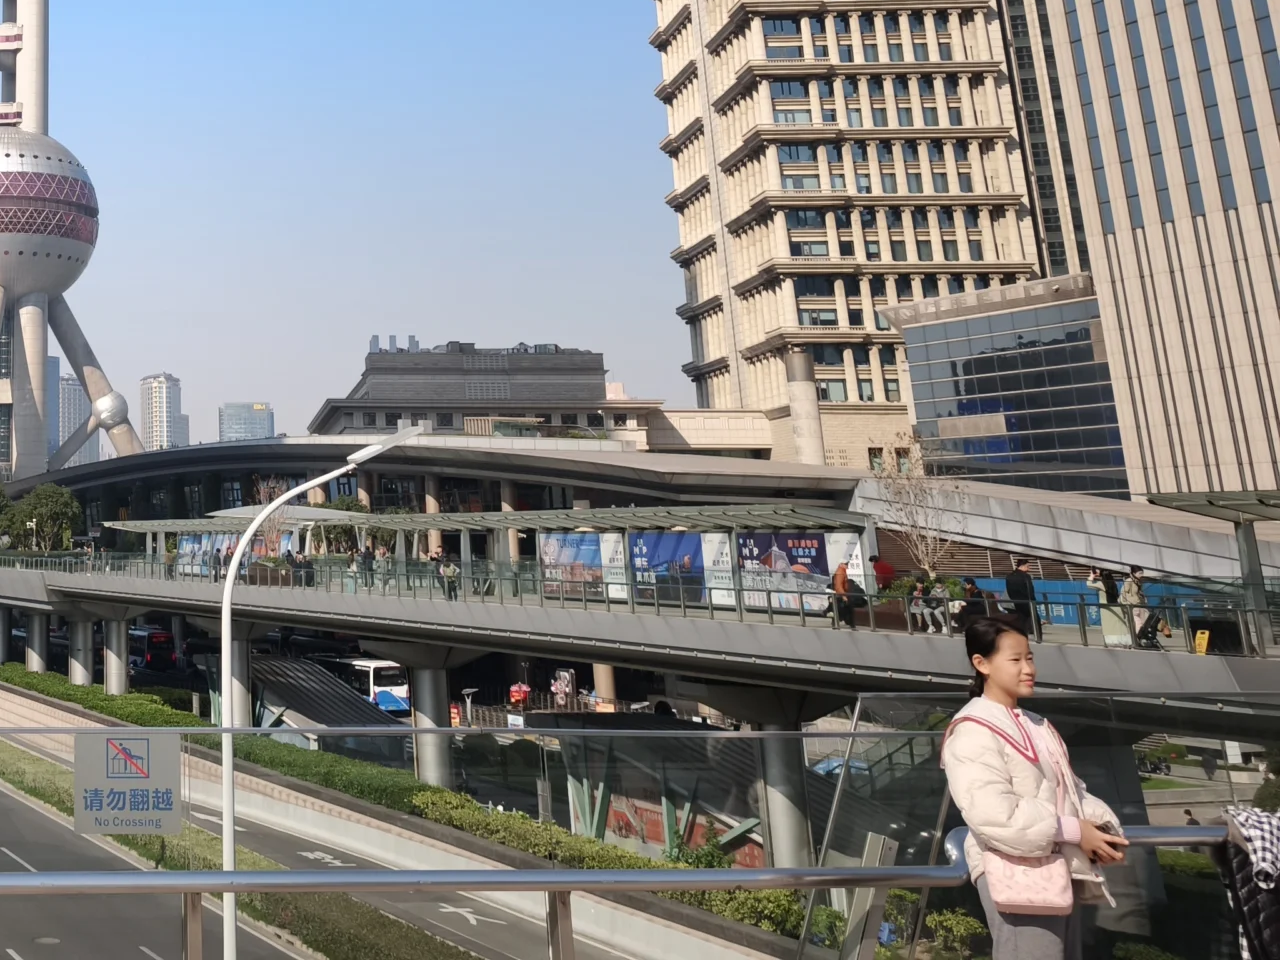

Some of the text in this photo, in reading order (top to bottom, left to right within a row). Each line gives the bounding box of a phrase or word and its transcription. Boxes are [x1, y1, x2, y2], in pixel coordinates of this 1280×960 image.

[82, 788, 173, 812] 请勿翻越
[94, 816, 162, 828] No Crossing
